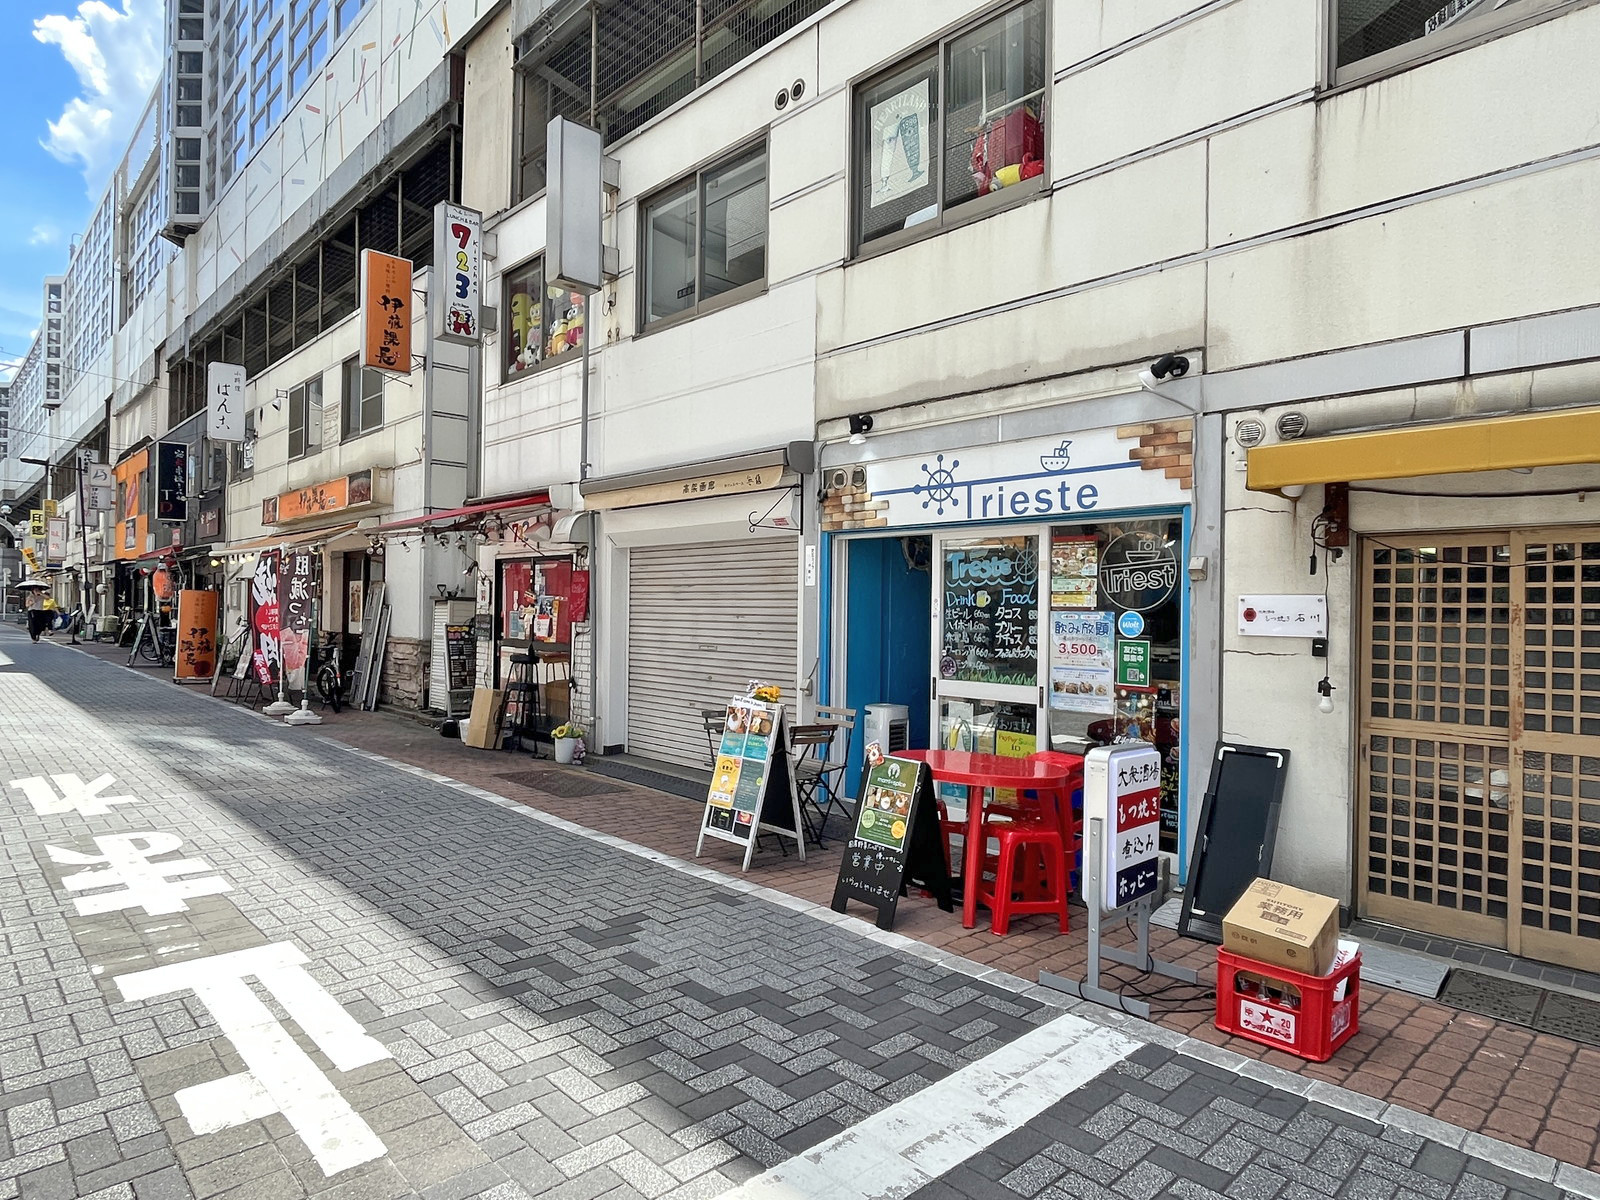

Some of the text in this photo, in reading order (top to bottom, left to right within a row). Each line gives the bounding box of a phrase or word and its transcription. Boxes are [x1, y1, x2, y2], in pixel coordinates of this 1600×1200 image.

[967, 480, 1099, 519] Trieste
[946, 589, 976, 607] Drink
[1000, 584, 1037, 606] Food
[945, 608, 973, 620] 生ビール
[995, 607, 1022, 620] タコス
[1055, 621, 1110, 636] 飲み放題
[1123, 645, 1144, 654] 友だち
[1117, 761, 1160, 788] 大衆酒場
[1118, 796, 1158, 824] もつ焼き
[1121, 834, 1155, 855] 煮込み
[851, 852, 886, 876] 営業中
[1119, 871, 1156, 898] ホッピー
[1257, 901, 1304, 920] 業務用
[1266, 898, 1304, 911] SUNTORY
[1243, 1018, 1292, 1040] サッポロビール
[1280, 1018, 1291, 1030] 20
